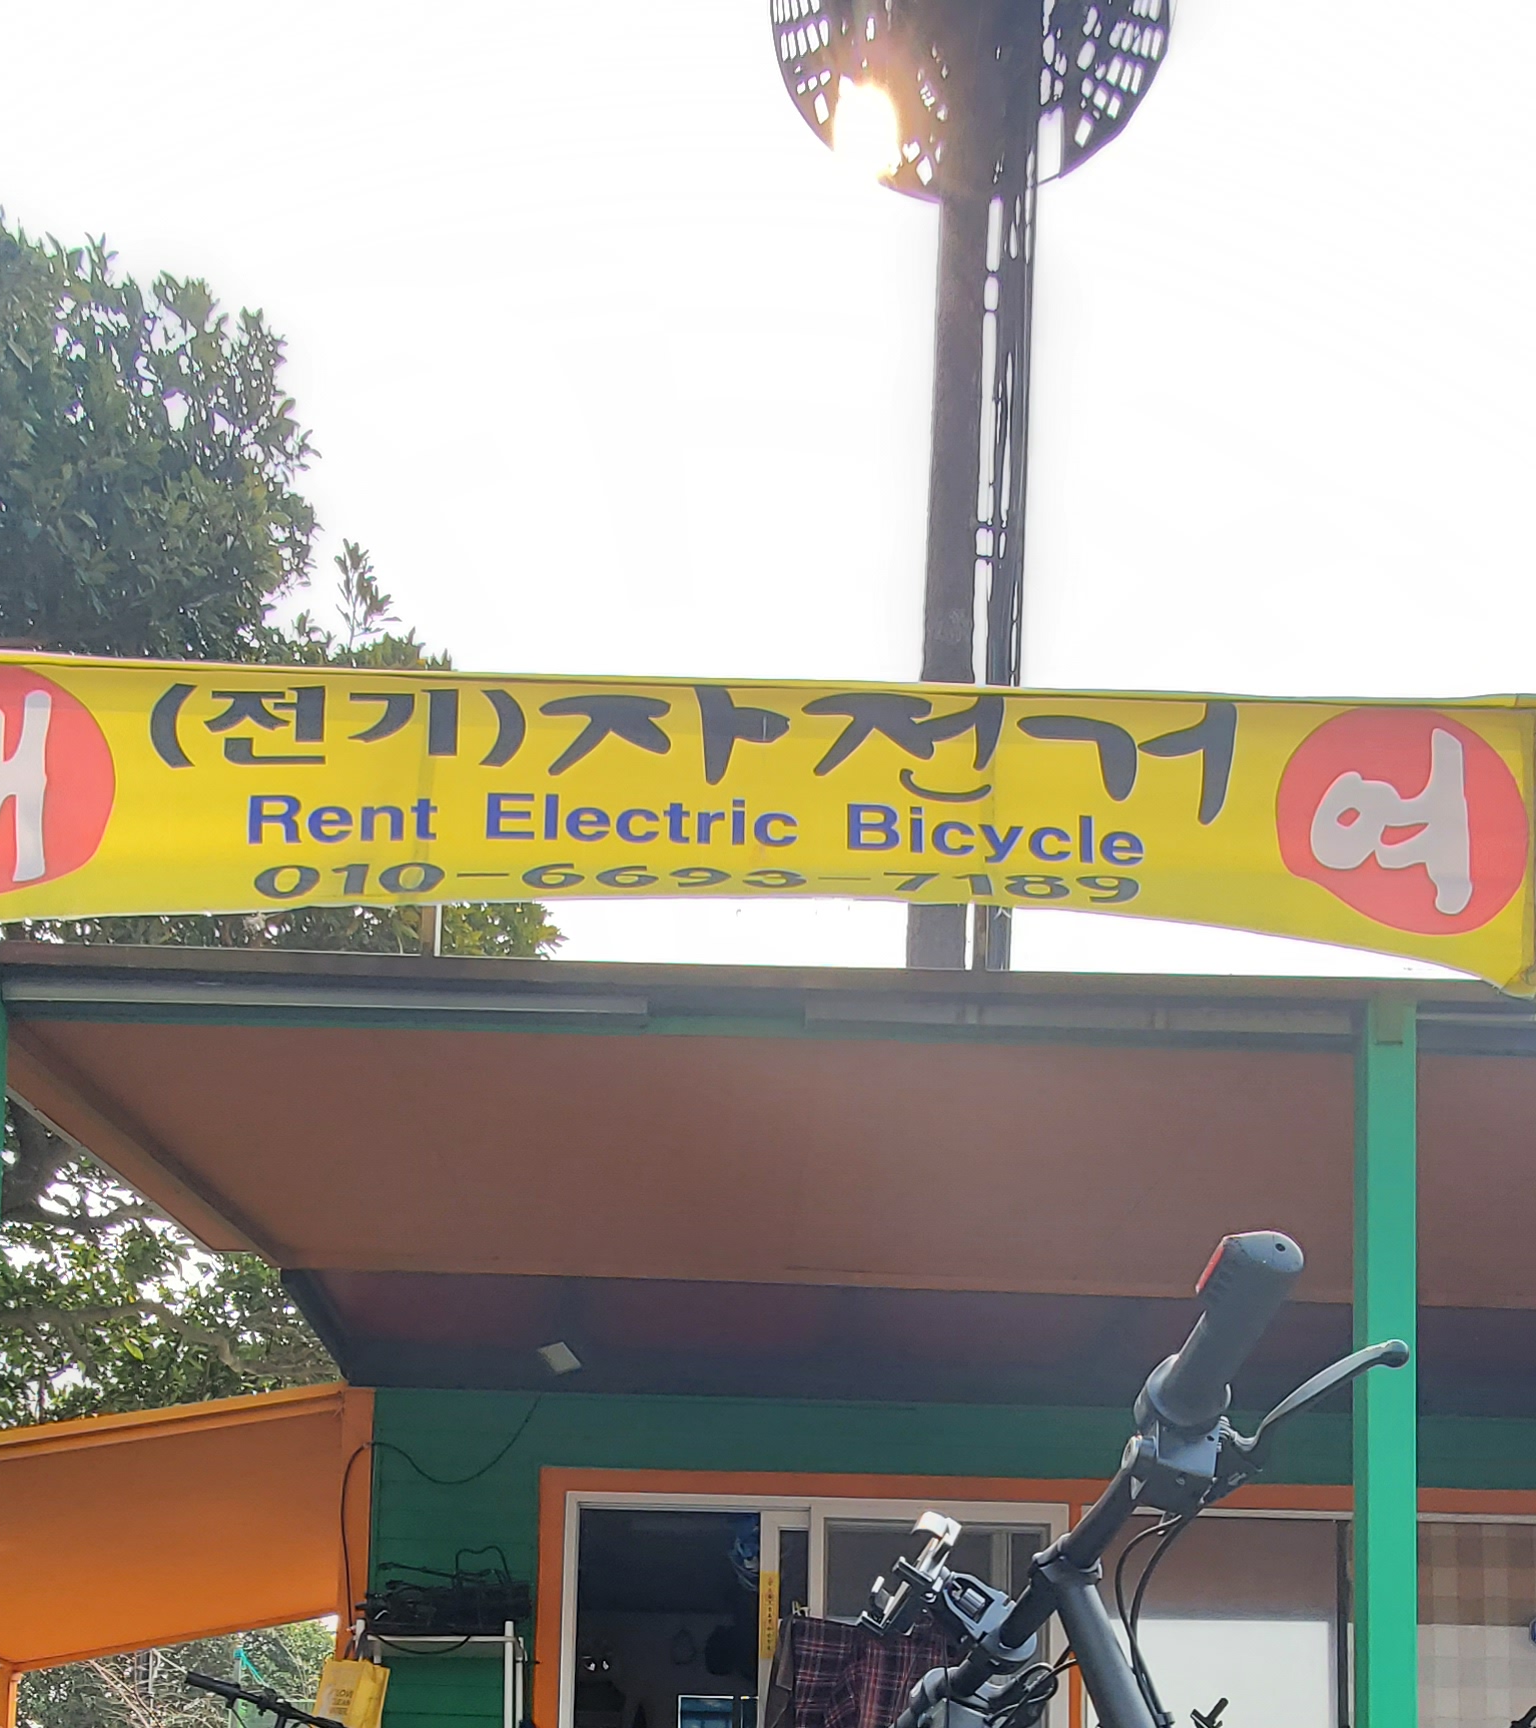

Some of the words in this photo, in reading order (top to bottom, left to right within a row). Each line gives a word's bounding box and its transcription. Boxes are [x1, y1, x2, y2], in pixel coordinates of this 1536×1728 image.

[249, 794, 438, 843] Rent
[487, 793, 798, 846] Electric
[846, 803, 1144, 866] Bicycle
[1310, 728, 1473, 915] 여
[253, 861, 1142, 905] 010-6693-7189
